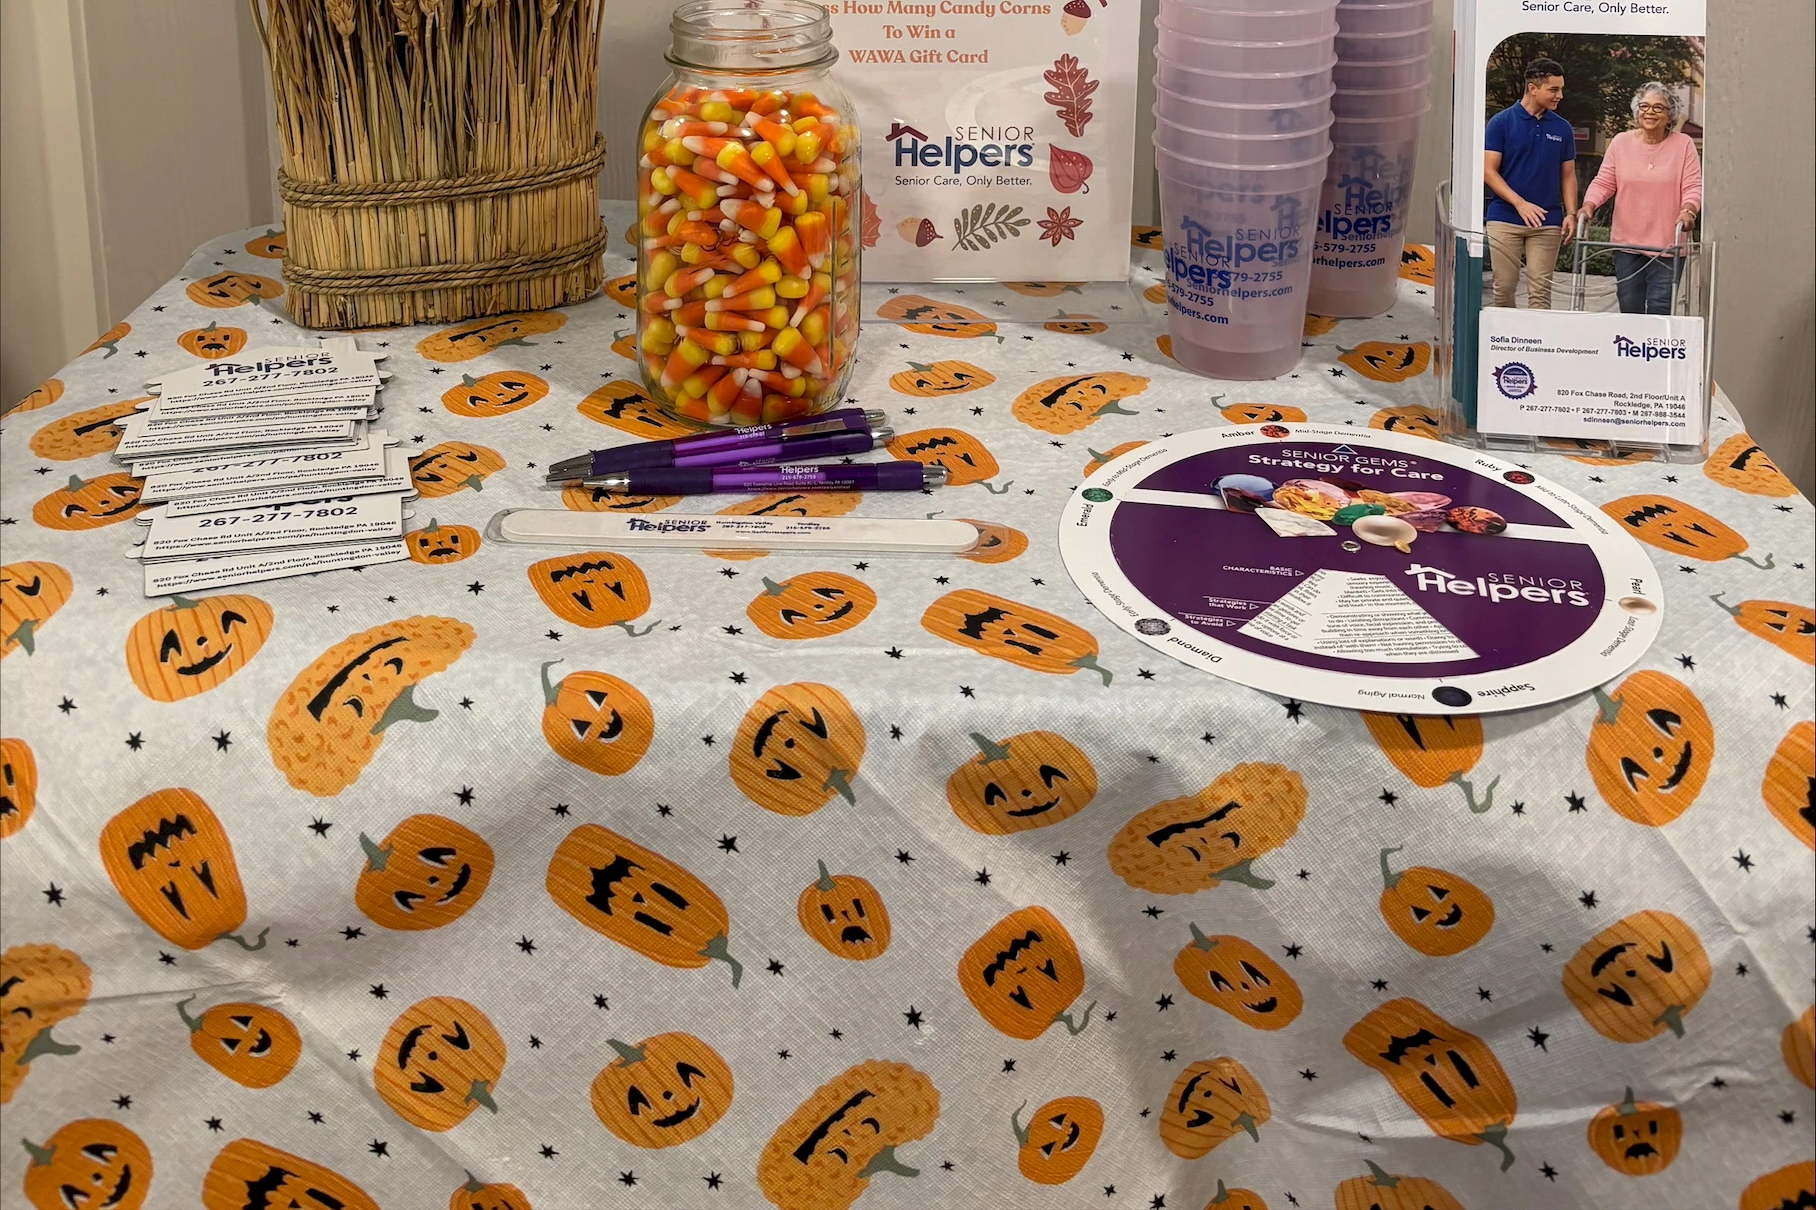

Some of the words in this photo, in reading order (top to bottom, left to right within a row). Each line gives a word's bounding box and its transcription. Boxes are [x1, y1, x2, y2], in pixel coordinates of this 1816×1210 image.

[843, 0, 883, 15] How
[886, 0, 936, 17] Many
[940, 0, 995, 17] Candy
[1000, 0, 1051, 15] Corns
[1522, 1, 1560, 12] Senior
[1563, 1, 1594, 14] Care,
[1598, 2, 1627, 16] Only
[1630, 3, 1669, 14] Better.
[883, 25, 902, 39] To
[906, 24, 941, 39] Win
[945, 28, 956, 39] a
[848, 49, 906, 64] WAWA
[910, 49, 943, 64] Gift
[946, 49, 989, 64] Card
[955, 126, 1034, 141] SENIOR
[895, 136, 1034, 174] Helpers
[895, 175, 930, 186] Senior
[933, 175, 962, 187] Care,
[966, 175, 992, 188] Only
[996, 175, 1032, 186] Better.
[1334, 201, 1392, 215] SENIOR
[1317, 210, 1391, 240] elpers
[1236, 226, 1300, 241] SENIOR
[1187, 229, 1299, 268] Helpers
[1314, 241, 1376, 253] 5-579-2755
[1174, 242, 1230, 268] SENIOR
[1165, 247, 1231, 290] elpers
[1312, 257, 1385, 269] rhelpers.com
[1167, 280, 1214, 306] 5-579-2755
[1490, 335, 1510, 344] Sofia
[1511, 336, 1542, 345] Dinneen
[1647, 338, 1686, 347] SENIOR
[265, 352, 333, 362] SENIOR
[1525, 346, 1555, 354] Business
[1617, 343, 1686, 362] Helpers
[213, 357, 332, 376] Helpers
[203, 367, 339, 387] 267-277-7802
[1585, 390, 1607, 398] Chase
[1644, 393, 1679, 401] Floor/Unit
[1526, 405, 1570, 413] 267-277-7802
[1614, 401, 1652, 409] Rockledge,
[736, 424, 772, 434] Helpers
[1583, 416, 1686, 428] sdinneen@seniorhelpers.com
[1221, 430, 1255, 439] Amber
[1141, 447, 1167, 464] Dementia
[1282, 449, 1349, 462] SENIOR
[781, 466, 819, 475] Helpers
[1248, 454, 1346, 473] Strategy
[1351, 463, 1384, 475] for
[1391, 467, 1444, 481] Care
[1475, 459, 1501, 471] Ruby
[198, 507, 358, 528] 267-277-7802
[1076, 503, 1094, 527] Emerald
[630, 521, 707, 534] Helpers
[1223, 565, 1292, 576] CHARACTERISTICS
[1488, 573, 1584, 591] SENIOR
[1630, 578, 1646, 595] Pearl
[1417, 573, 1590, 607] Helpers
[1209, 597, 1247, 606] Strategies
[1184, 614, 1223, 623] Strategies
[1167, 636, 1223, 664] Diamond
[1600, 637, 1626, 656] Dementia
[1357, 688, 1387, 698] Aging
[1389, 691, 1426, 700] Normal
[1477, 683, 1535, 698] Sapphire
